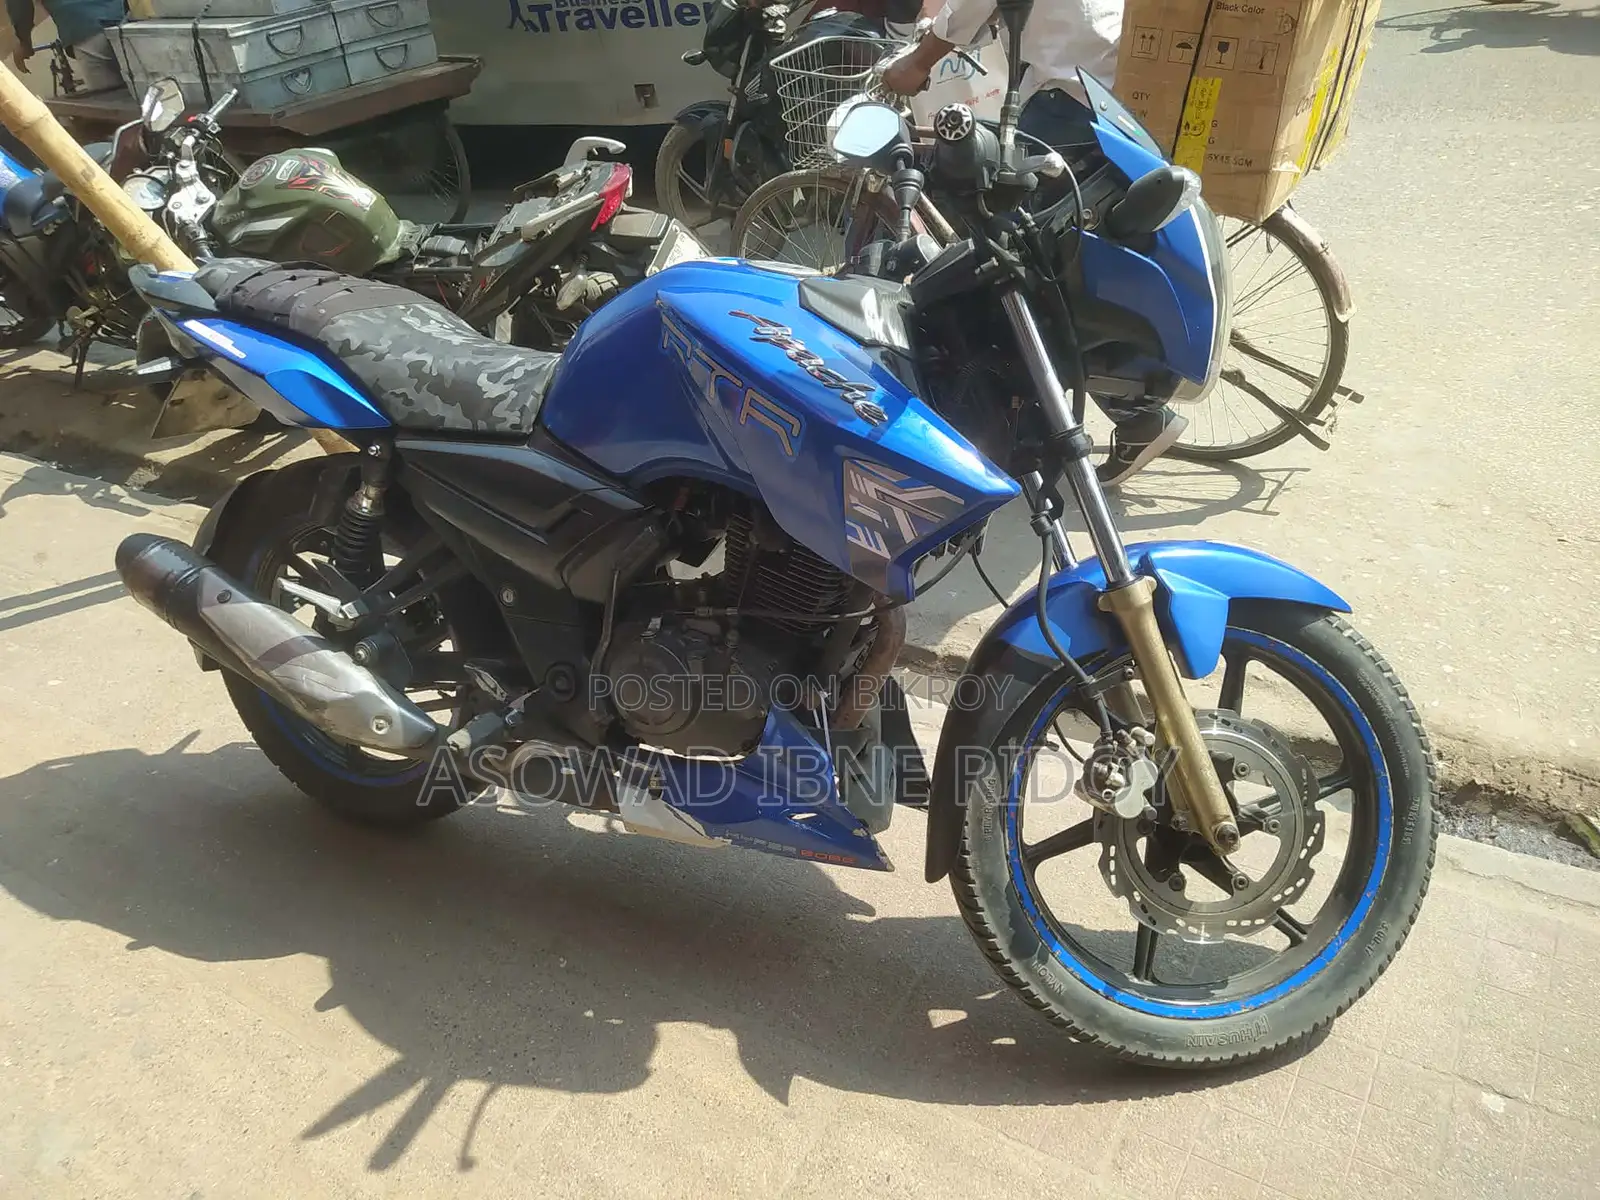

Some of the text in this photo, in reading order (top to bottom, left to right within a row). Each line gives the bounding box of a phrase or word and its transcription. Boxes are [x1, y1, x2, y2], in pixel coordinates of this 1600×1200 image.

[1215, 2, 1266, 15] Black Color
[1131, 91, 1151, 101] QTY
[728, 309, 889, 427] Apache
